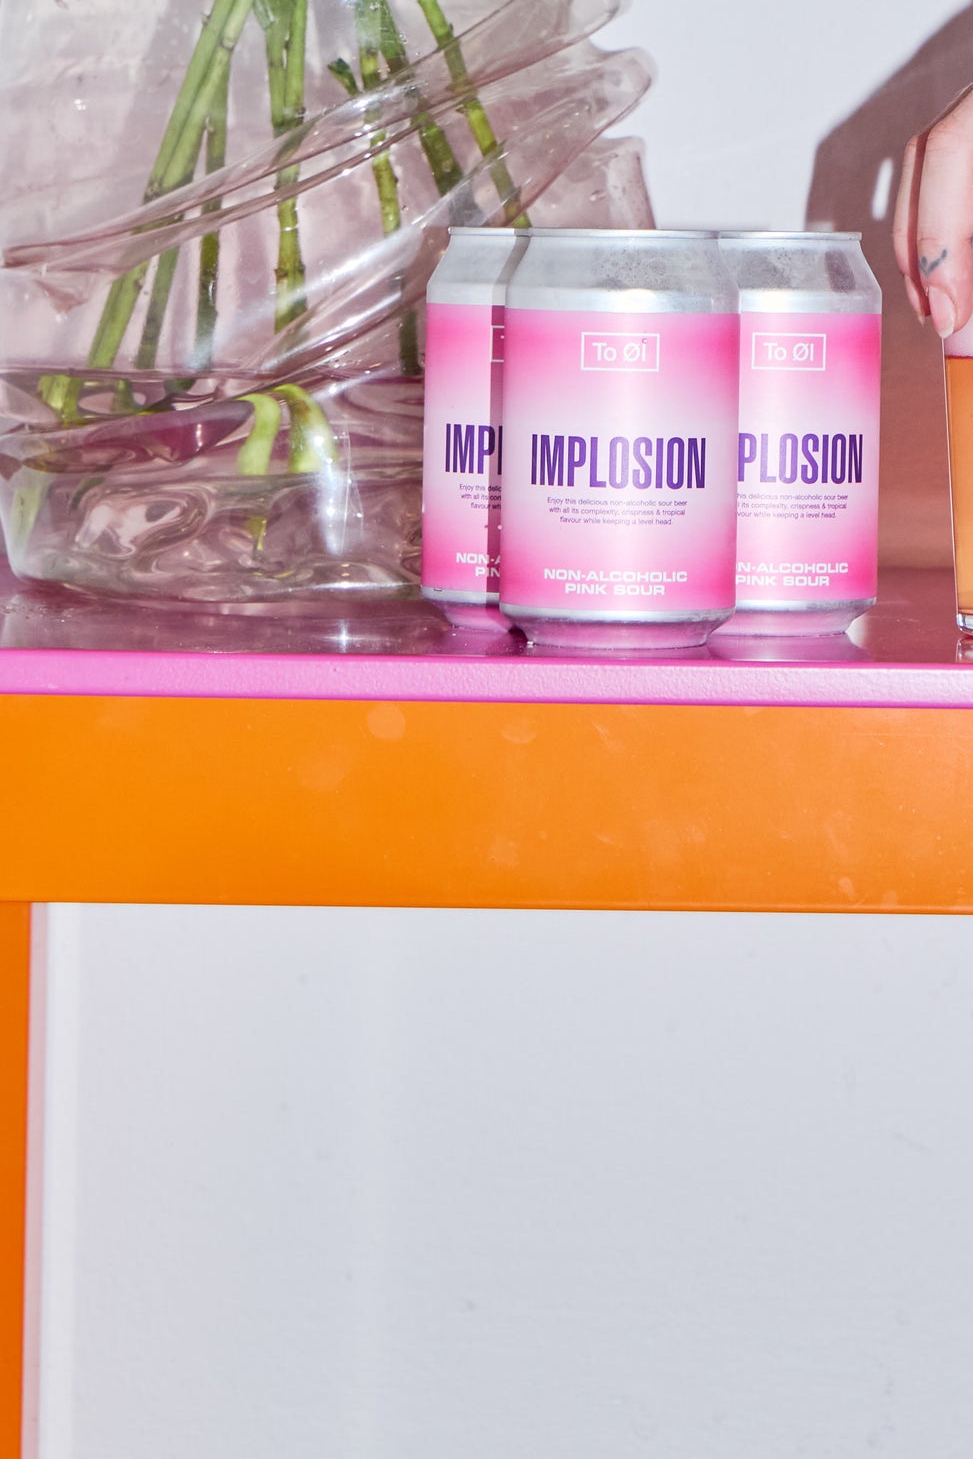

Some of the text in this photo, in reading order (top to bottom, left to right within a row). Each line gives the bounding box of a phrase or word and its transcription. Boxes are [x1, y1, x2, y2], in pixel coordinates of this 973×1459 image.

[592, 342, 618, 362] To
[763, 342, 787, 361] To
[531, 434, 707, 490] IMPLOSION
[459, 483, 474, 492] Enjoy
[547, 496, 564, 506] Enjoy
[565, 497, 577, 505] this
[578, 498, 608, 506] delicious
[610, 499, 657, 507] non-alcoholic
[674, 499, 688, 507] beer
[780, 493, 822, 501] non-alcoholic
[790, 502, 820, 510] crispness
[827, 502, 847, 510] tropical
[621, 508, 654, 517] crispness
[662, 509, 685, 517] tropical
[772, 511, 799, 520] keeping
[560, 516, 581, 524] flavour
[602, 517, 631, 526] keeping
[544, 568, 688, 583] NON-ALCOHOLIC
[735, 574, 830, 587] PINK SOUR
[565, 583, 666, 596] PINK SOUR
